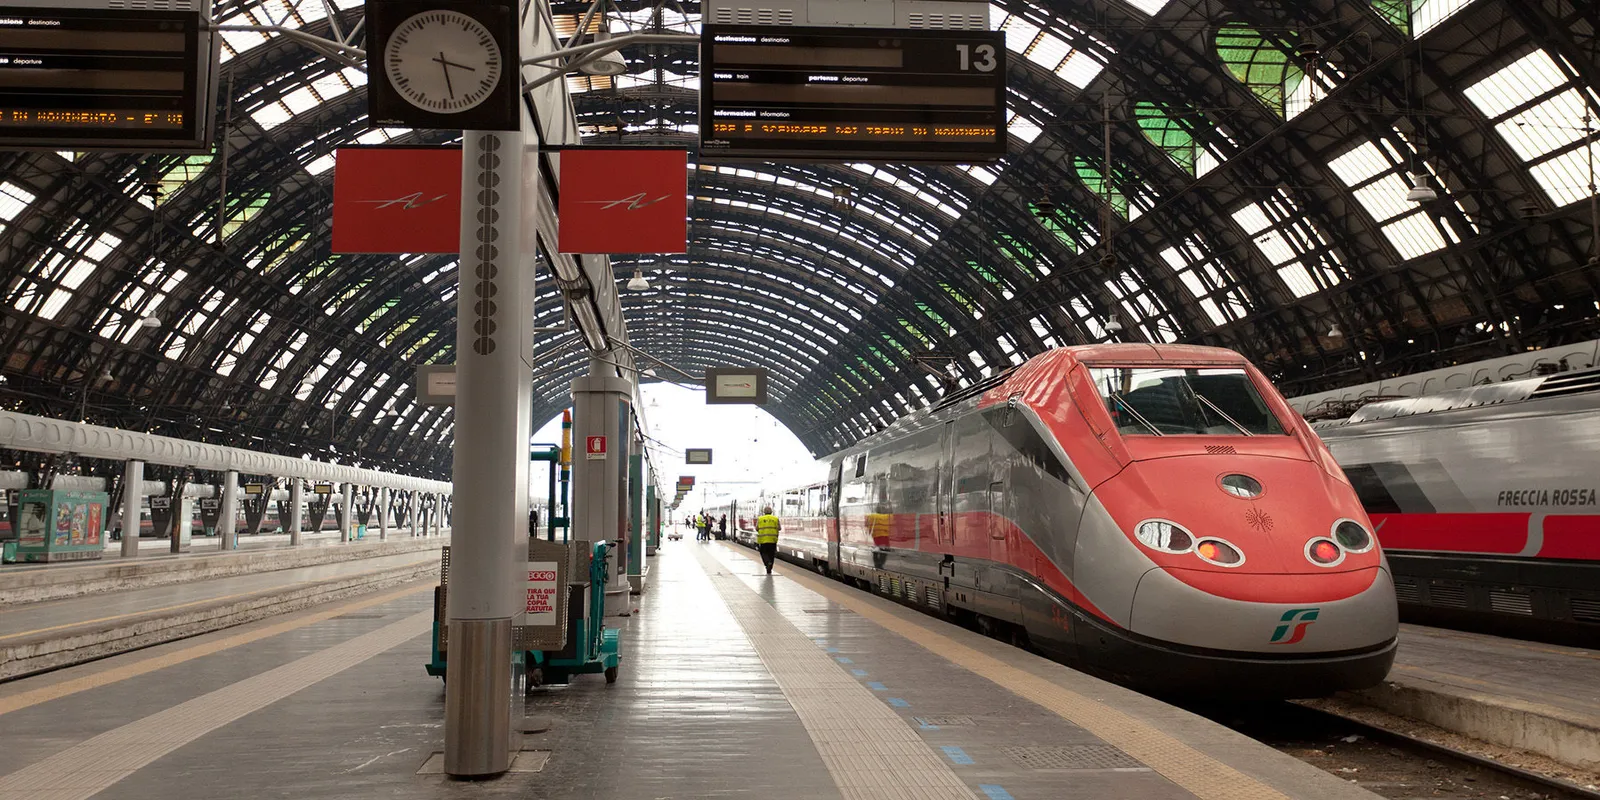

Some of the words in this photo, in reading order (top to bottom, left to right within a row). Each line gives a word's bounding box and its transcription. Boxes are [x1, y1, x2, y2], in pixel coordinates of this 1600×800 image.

[13, 57, 43, 65] departure
[956, 44, 997, 72] 13
[842, 75, 869, 83] departure
[37, 111, 117, 123] MOVIMENTO
[714, 109, 756, 117] informazioni
[761, 125, 827, 135] SCENDERE
[866, 127, 905, 135] TRENI
[1497, 489, 1549, 506] FRECCIA
[1551, 488, 1597, 506] ROSSA
